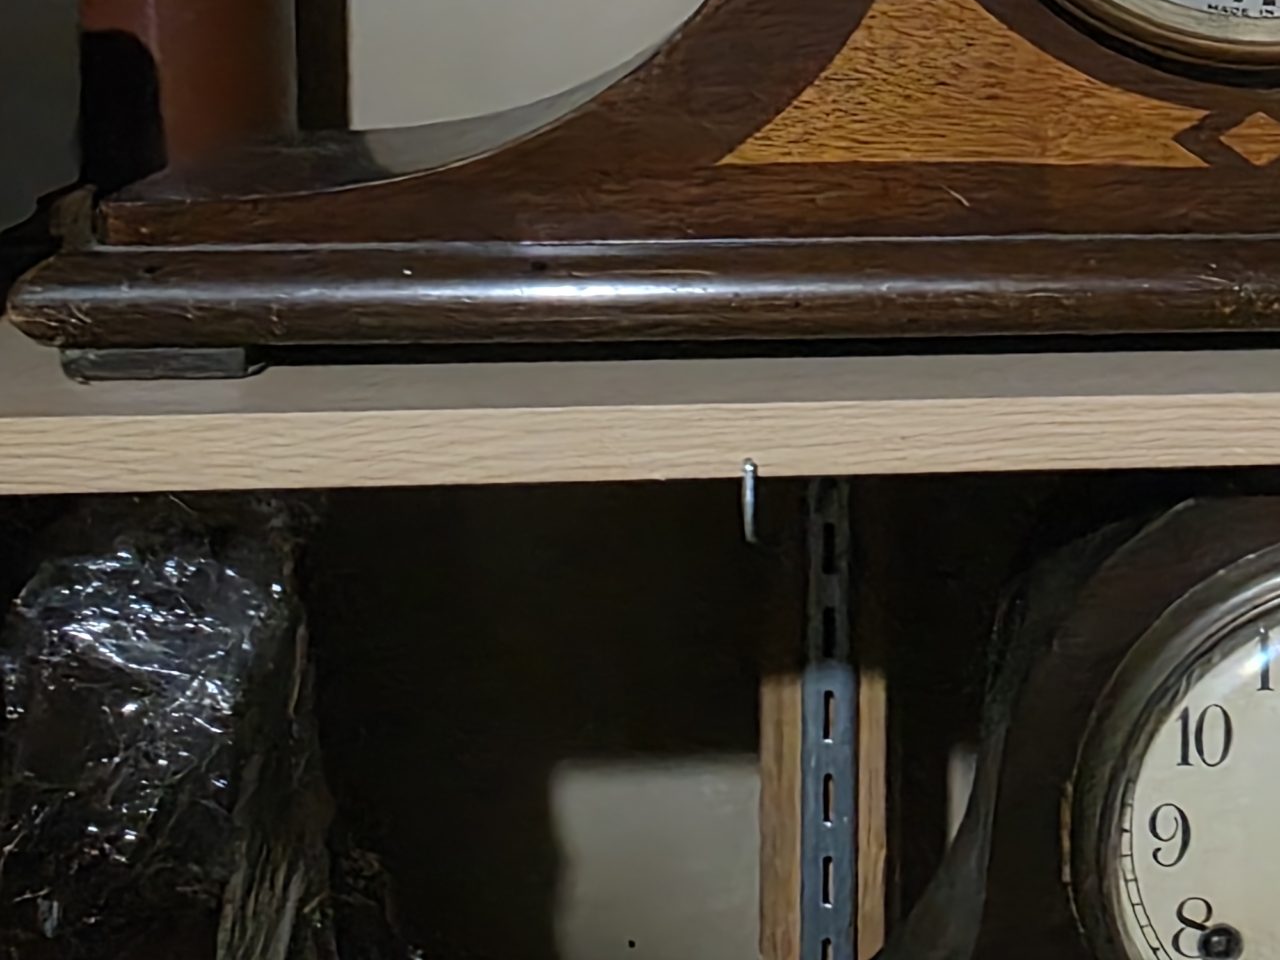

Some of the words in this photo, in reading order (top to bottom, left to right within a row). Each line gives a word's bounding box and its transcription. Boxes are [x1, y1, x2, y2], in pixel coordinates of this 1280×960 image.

[1207, 3, 1250, 17] MADE
[1175, 704, 1233, 767] 10
[1149, 802, 1191, 867] 9
[1171, 897, 1214, 959] 8
